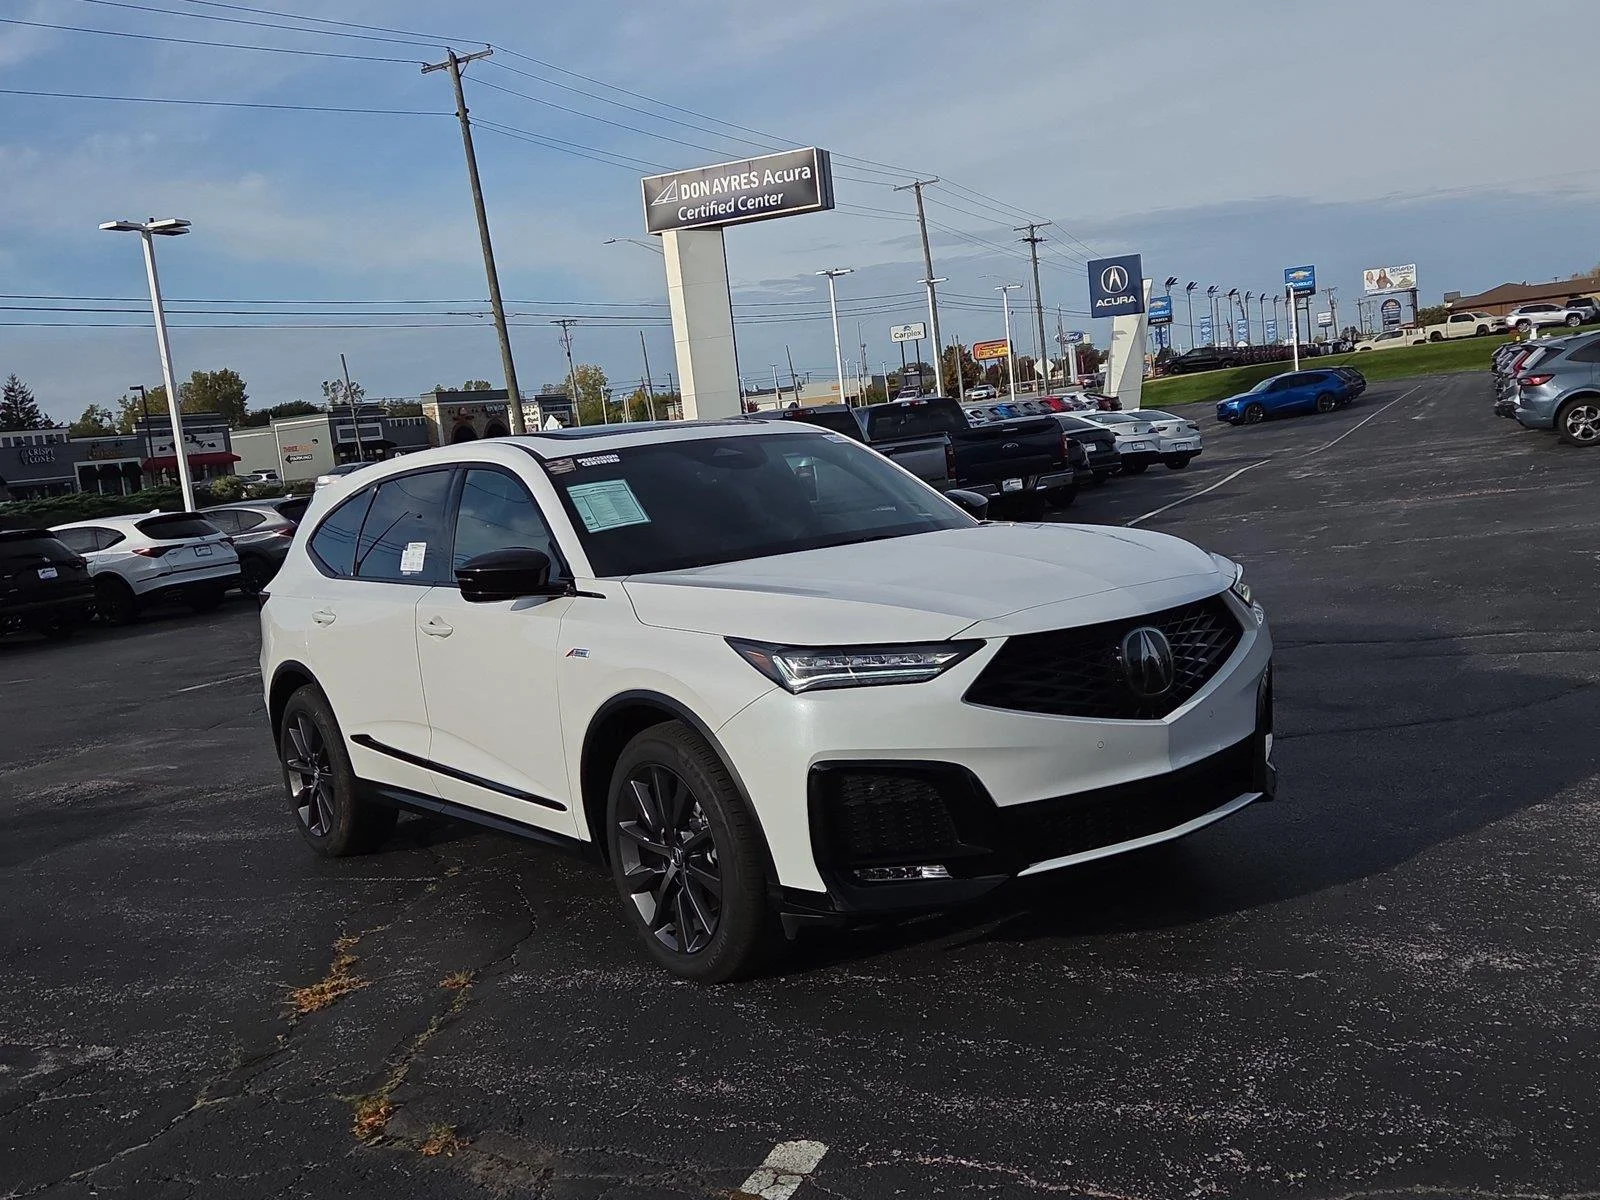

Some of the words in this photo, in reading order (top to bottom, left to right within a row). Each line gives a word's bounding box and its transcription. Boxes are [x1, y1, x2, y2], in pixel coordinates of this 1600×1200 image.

[680, 180, 710, 200] DON
[713, 171, 759, 195] AYRES
[763, 166, 812, 187] Acura
[678, 199, 735, 221] Certified
[737, 192, 783, 210] Center
[1096, 295, 1137, 308] ACURA
[893, 330, 922, 340] Carplex
[28, 447, 54, 456] CRISPY
[29, 455, 56, 464] CONES
[577, 454, 619, 464] PRECISION
[581, 458, 621, 467] CERTIFIED
